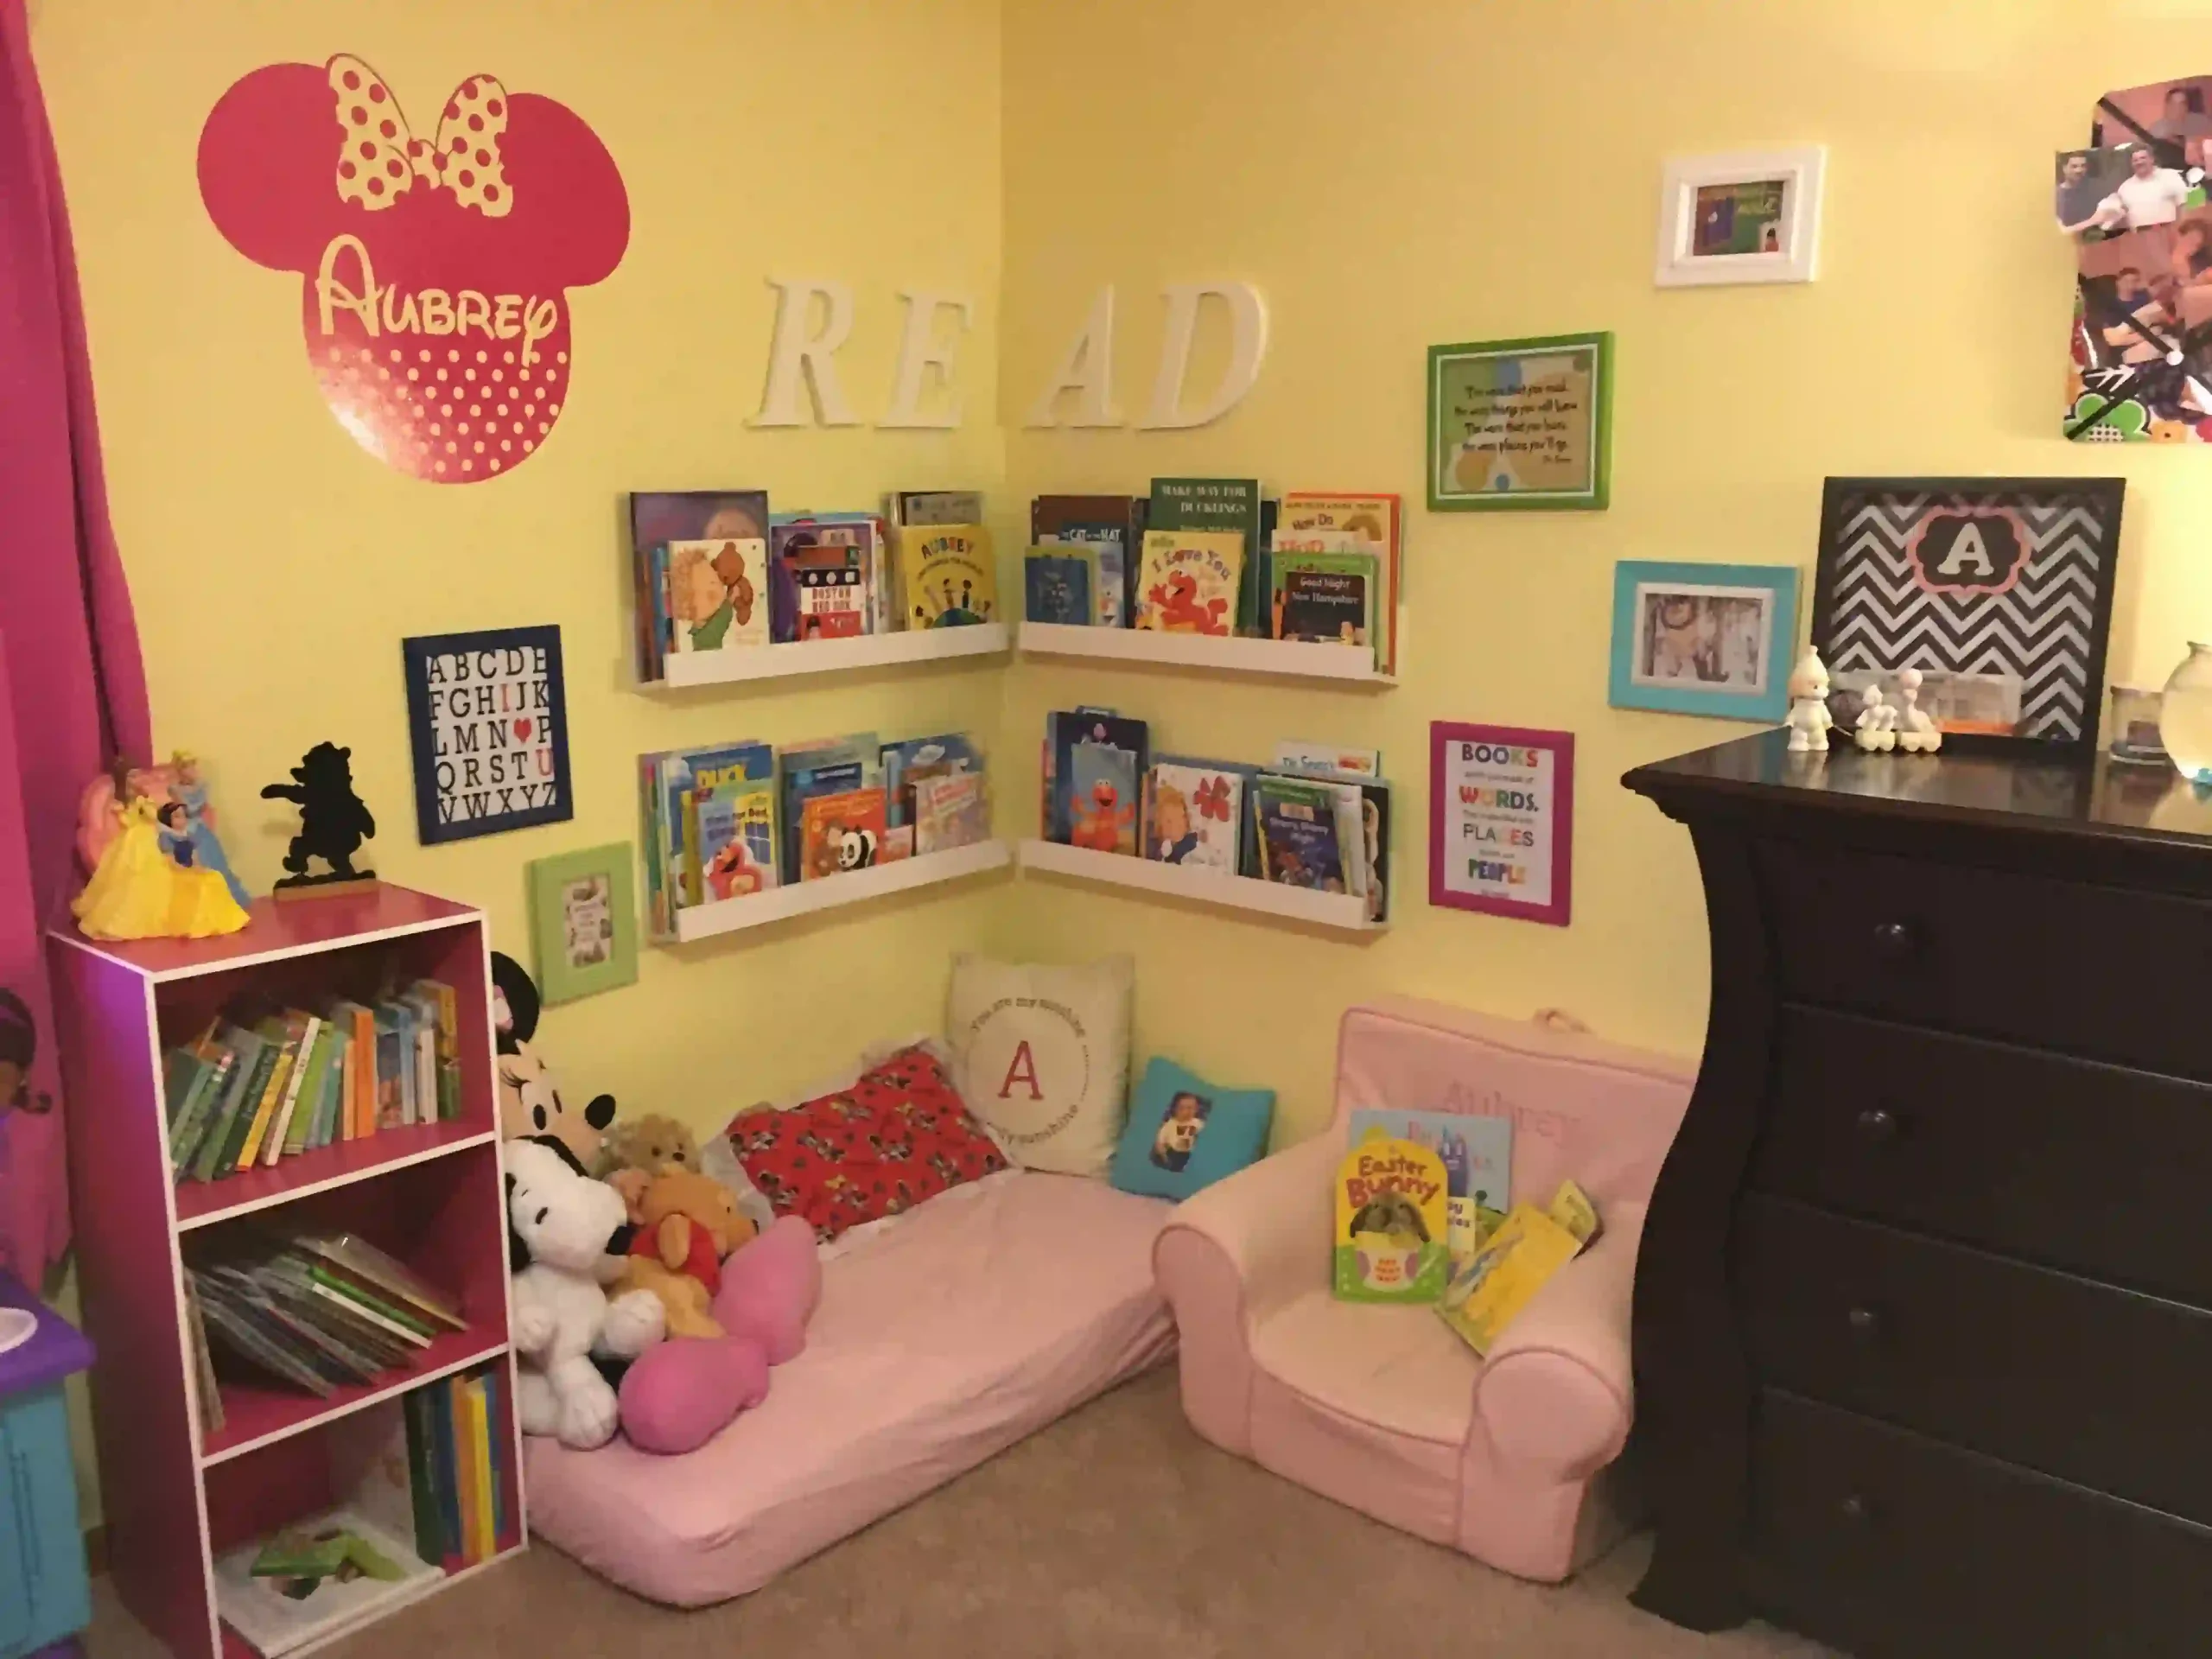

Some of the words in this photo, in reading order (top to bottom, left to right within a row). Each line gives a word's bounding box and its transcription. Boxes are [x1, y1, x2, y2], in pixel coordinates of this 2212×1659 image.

[1937, 522, 1994, 576] A
[1462, 743, 1539, 768] BOOKS
[997, 1039, 1046, 1102] A
[1358, 1155, 1428, 1177] Easter
[1346, 1175, 1441, 1209] Bunny
